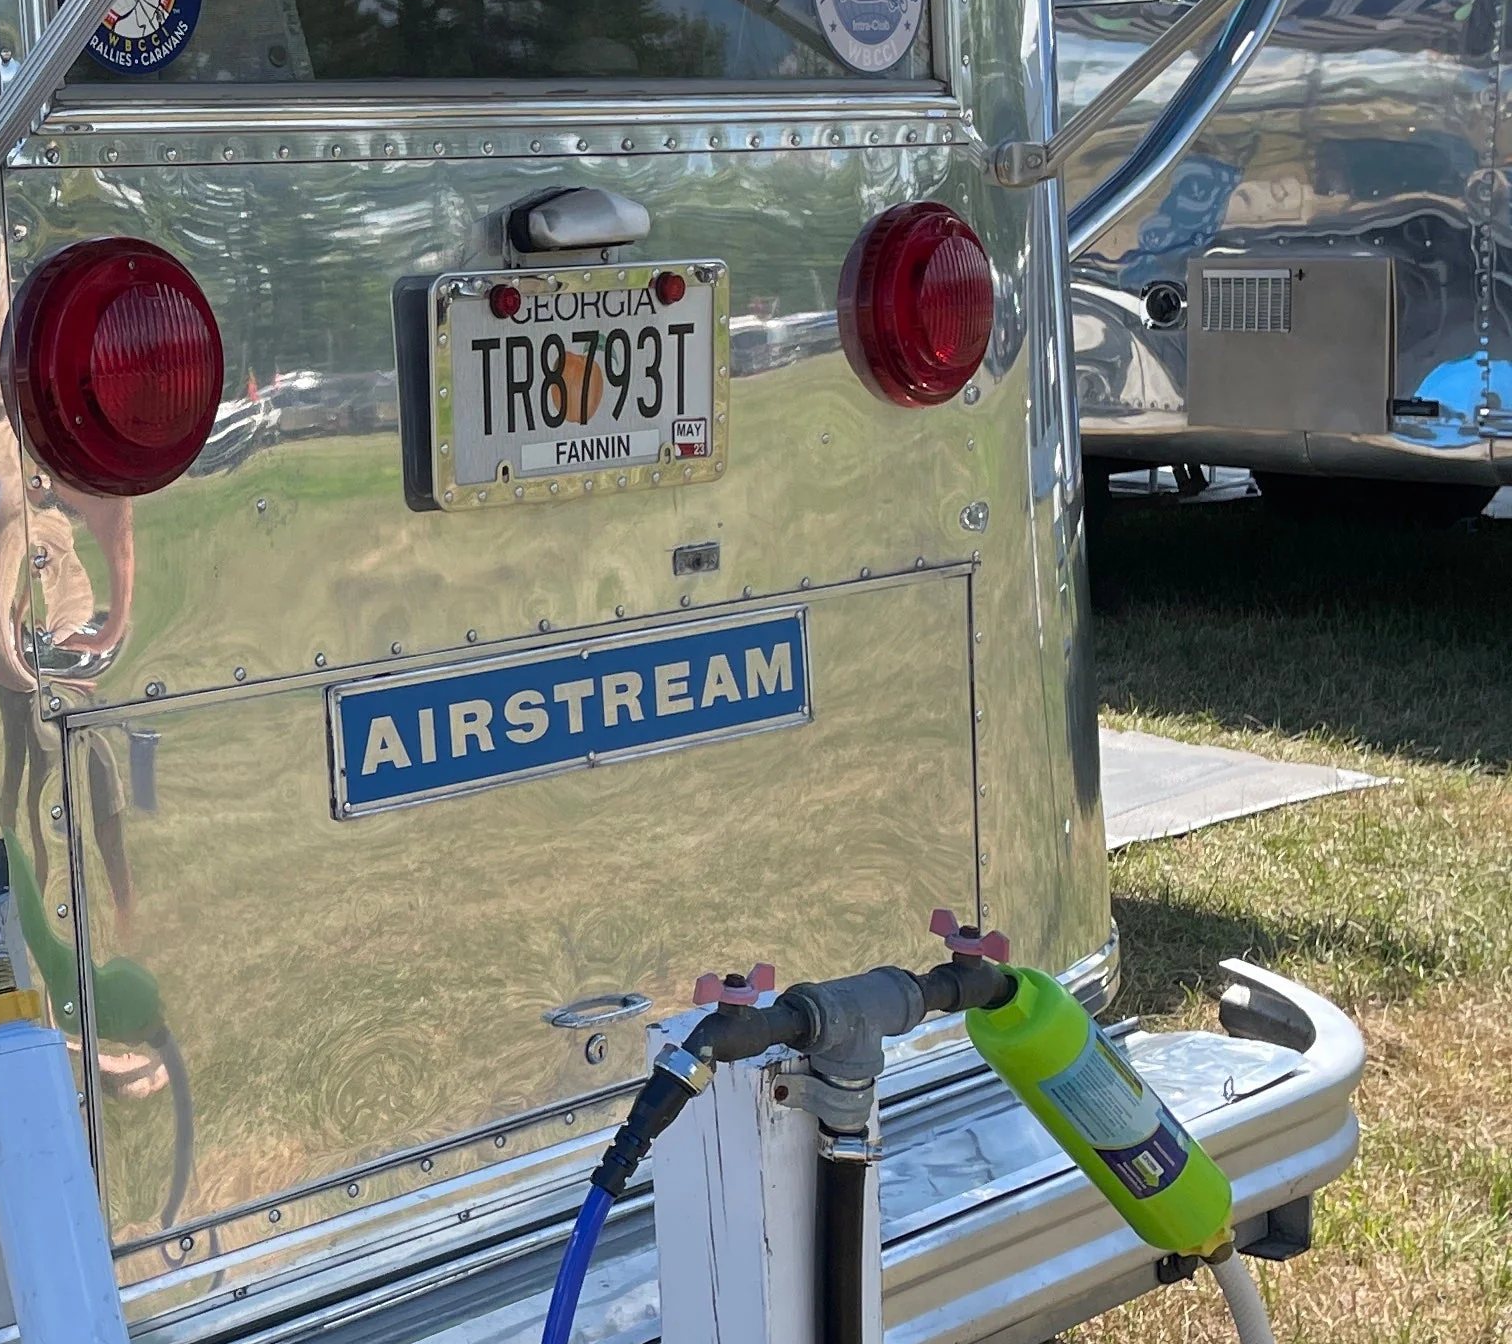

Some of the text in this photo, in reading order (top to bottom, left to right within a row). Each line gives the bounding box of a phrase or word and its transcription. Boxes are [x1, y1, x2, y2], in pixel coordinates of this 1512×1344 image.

[89, 20, 189, 67] RALLIES CARAVANS
[848, 39, 898, 67] WBCCI
[511, 286, 657, 325] GEORGIA
[471, 322, 695, 436] TR8793T
[677, 423, 702, 437] MAY
[555, 434, 630, 465] FANNIN
[693, 443, 705, 456] 23
[361, 641, 794, 776] AIRSTREAM
